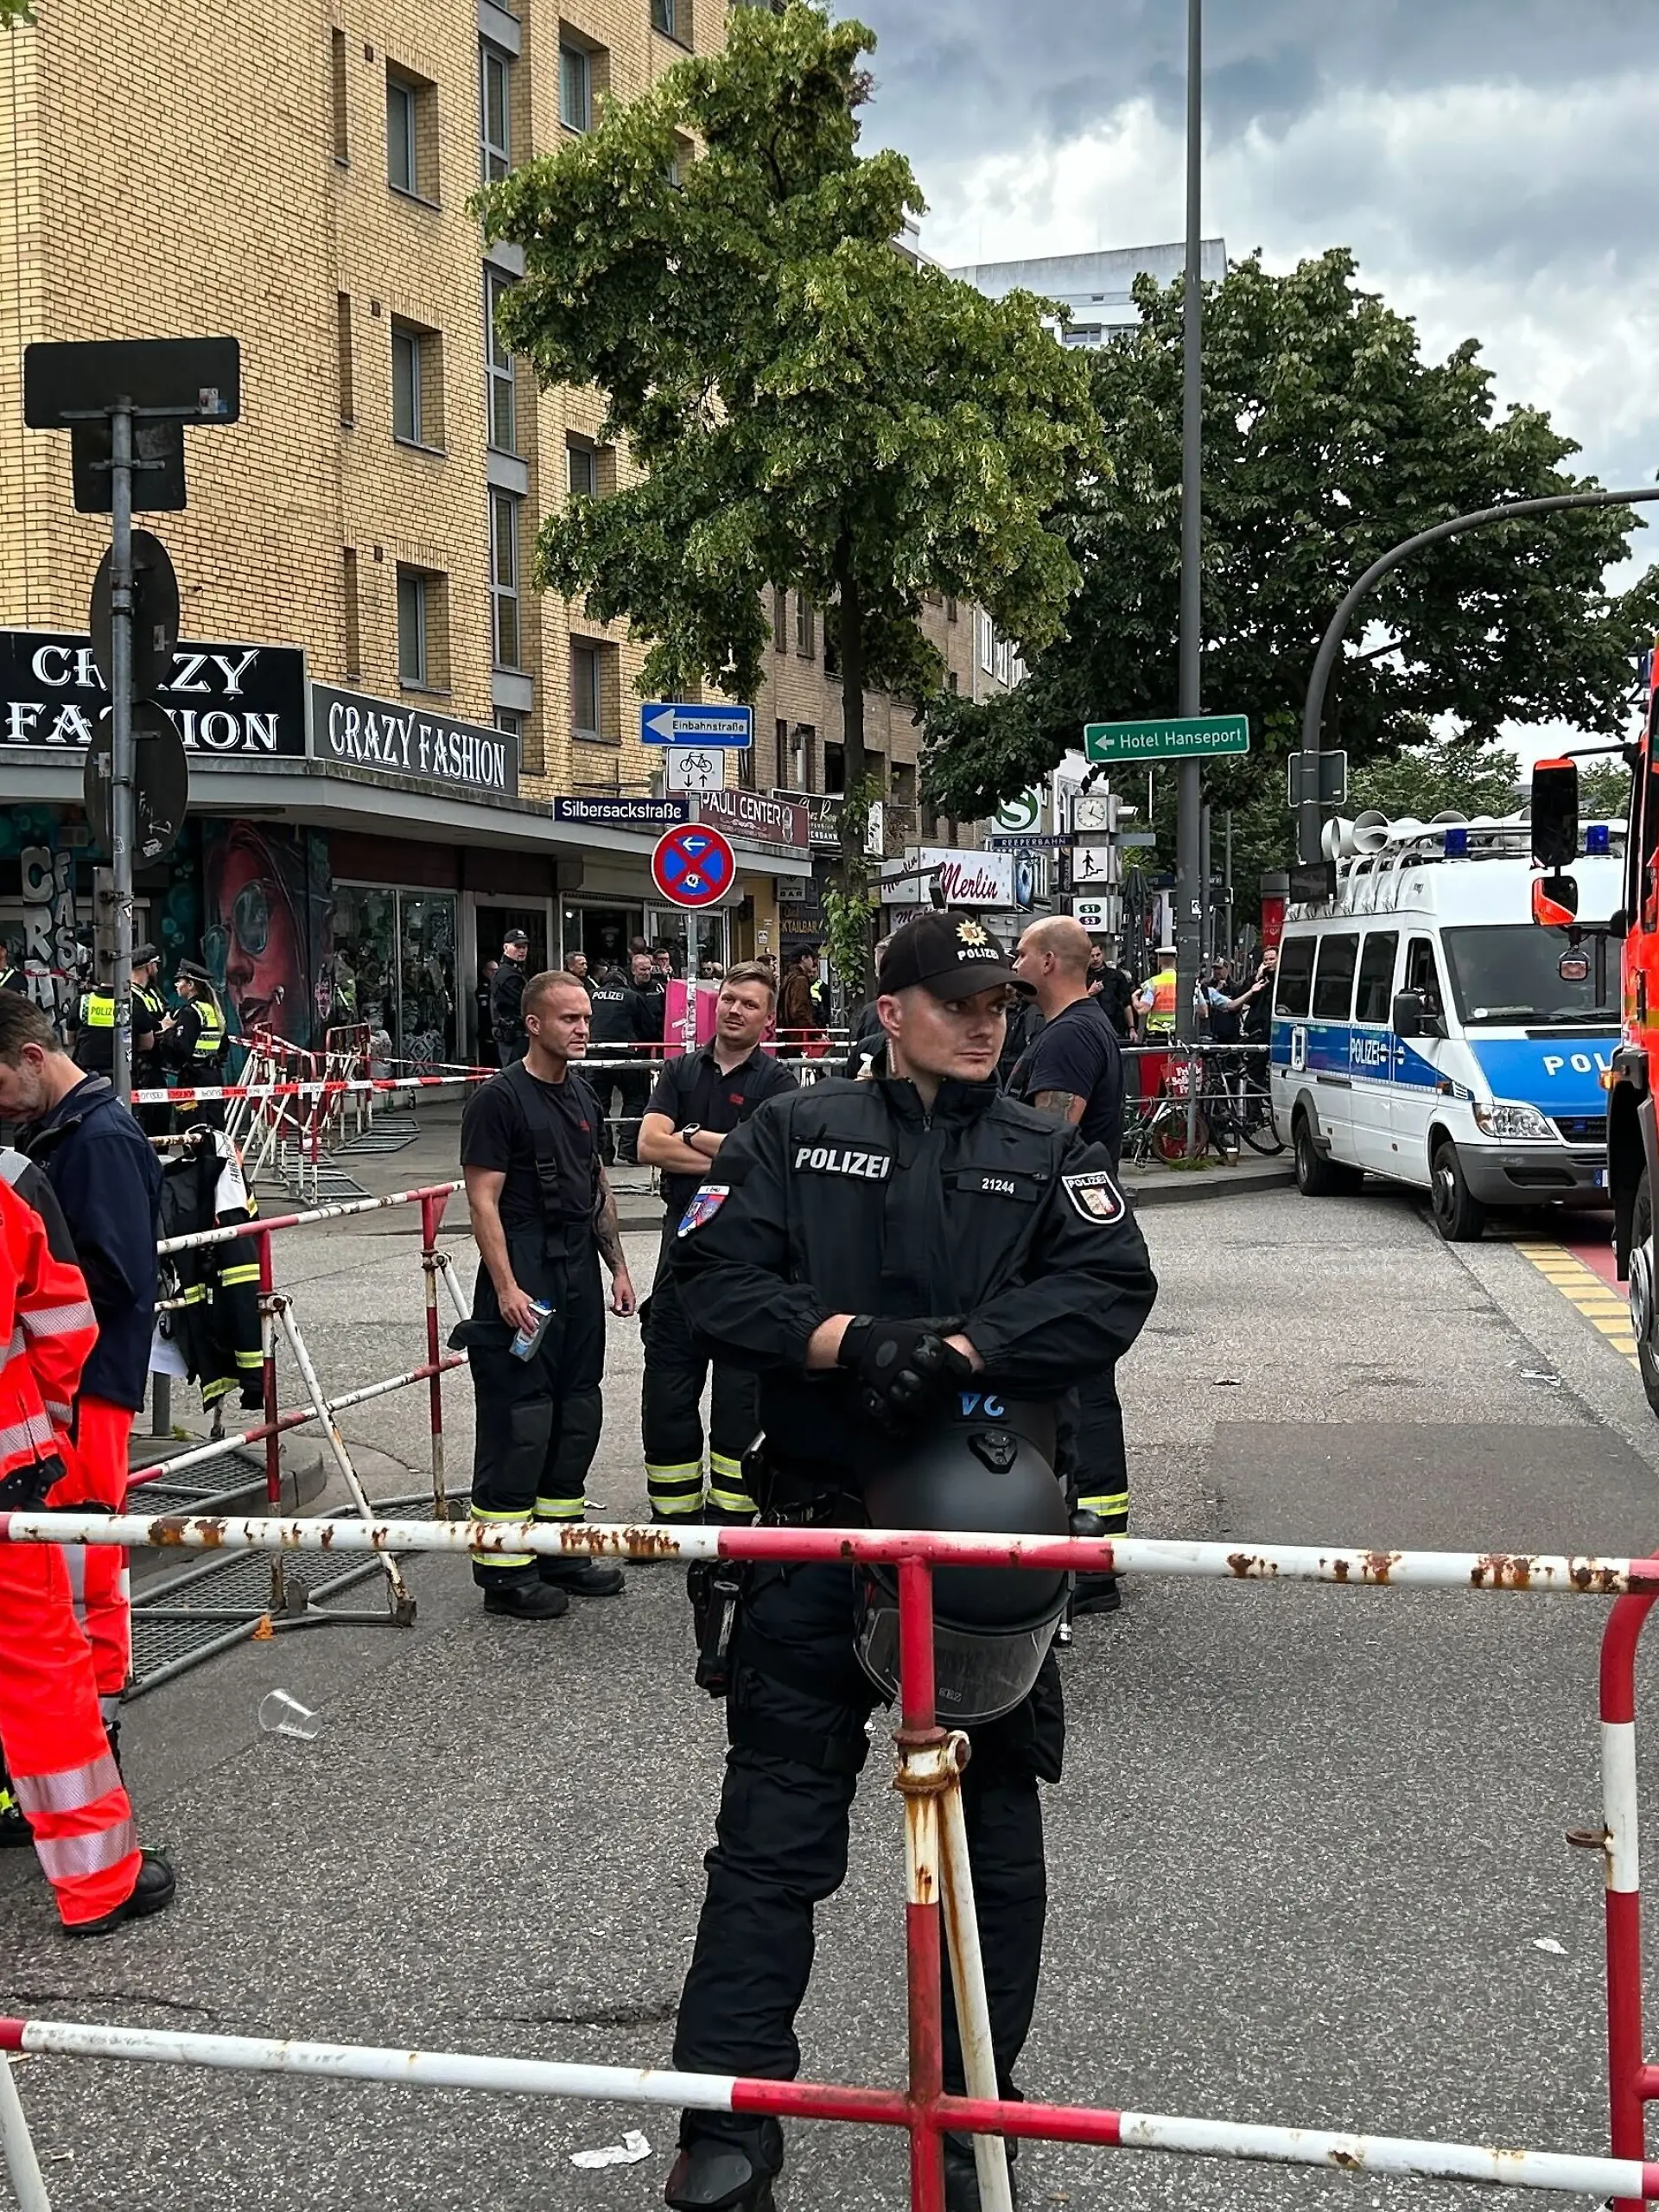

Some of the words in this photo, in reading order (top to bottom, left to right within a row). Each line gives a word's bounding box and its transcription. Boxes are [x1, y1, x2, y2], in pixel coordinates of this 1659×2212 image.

[31, 645, 260, 695] CRZY
[4, 701, 281, 752] FAION
[672, 720, 745, 733] Einbahnstraße
[328, 701, 416, 770] CRAZY
[418, 723, 507, 790] FASHION
[1120, 732, 1160, 749] Hotel
[1165, 728, 1243, 747] Hanseport
[562, 799, 683, 819] Silbersackstraße
[700, 791, 736, 817] PAULI
[740, 796, 781, 827] CENTER
[1001, 836, 1067, 847] REEPERBAHN
[939, 861, 999, 900] Merlin
[1083, 905, 1097, 913] S1
[592, 990, 624, 1001] POLIZEI
[90, 1005, 115, 1016] POLIZ
[1350, 1037, 1380, 1066] POLIZEI
[1542, 1052, 1612, 1077] POL
[794, 1147, 891, 1179] POLIZEI
[982, 1176, 1015, 1195] 21244
[1067, 1174, 1107, 1189] POLIZEI
